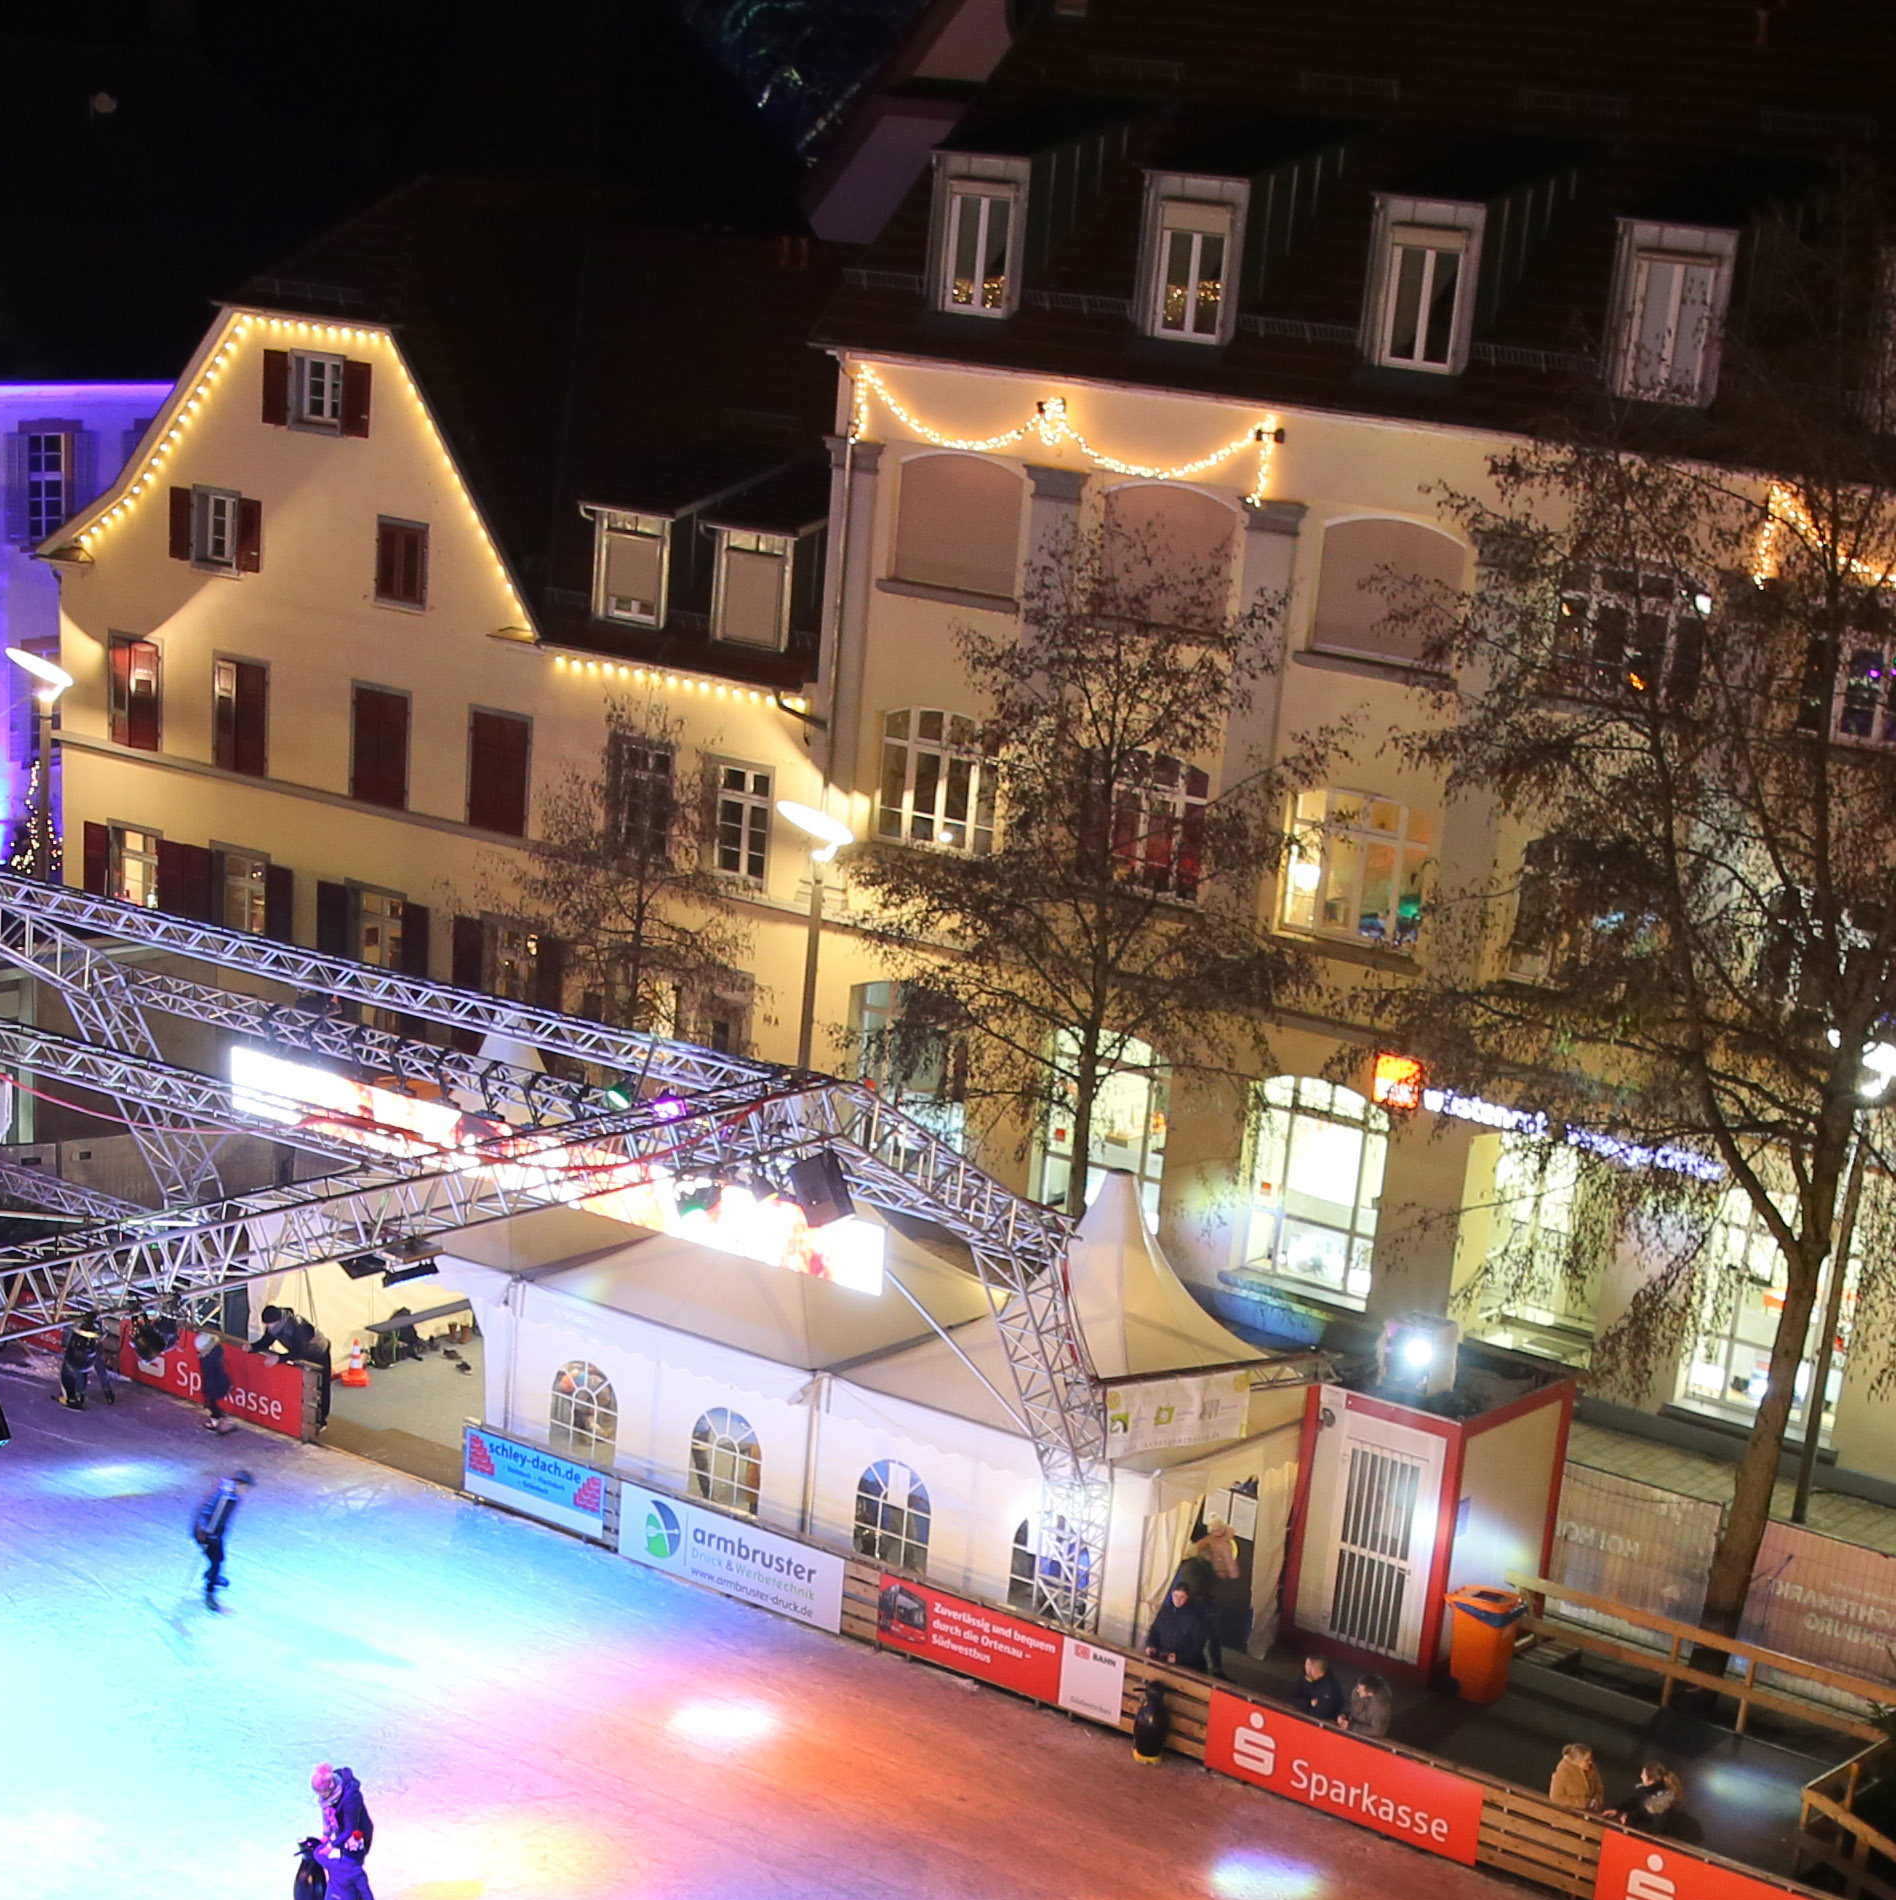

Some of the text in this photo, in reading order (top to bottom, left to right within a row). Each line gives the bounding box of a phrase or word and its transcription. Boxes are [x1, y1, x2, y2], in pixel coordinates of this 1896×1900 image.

[489, 1443, 582, 1484] schley-dach.de
[691, 1547, 723, 1568] Druck
[735, 1564, 815, 1601] Werbetechnik
[692, 1526, 817, 1584] armbruster
[691, 1566, 814, 1618] www.armbruster-druck.de
[931, 1633, 992, 1664] Südwestbus
[932, 1618, 962, 1638] durch
[963, 1626, 980, 1642] die
[980, 1634, 1023, 1659] Ortenau
[933, 1602, 1056, 1655] Zuverlässig und bequem
[1092, 1653, 1117, 1668] BAHN
[1291, 1758, 1450, 1842] Sparkasse
